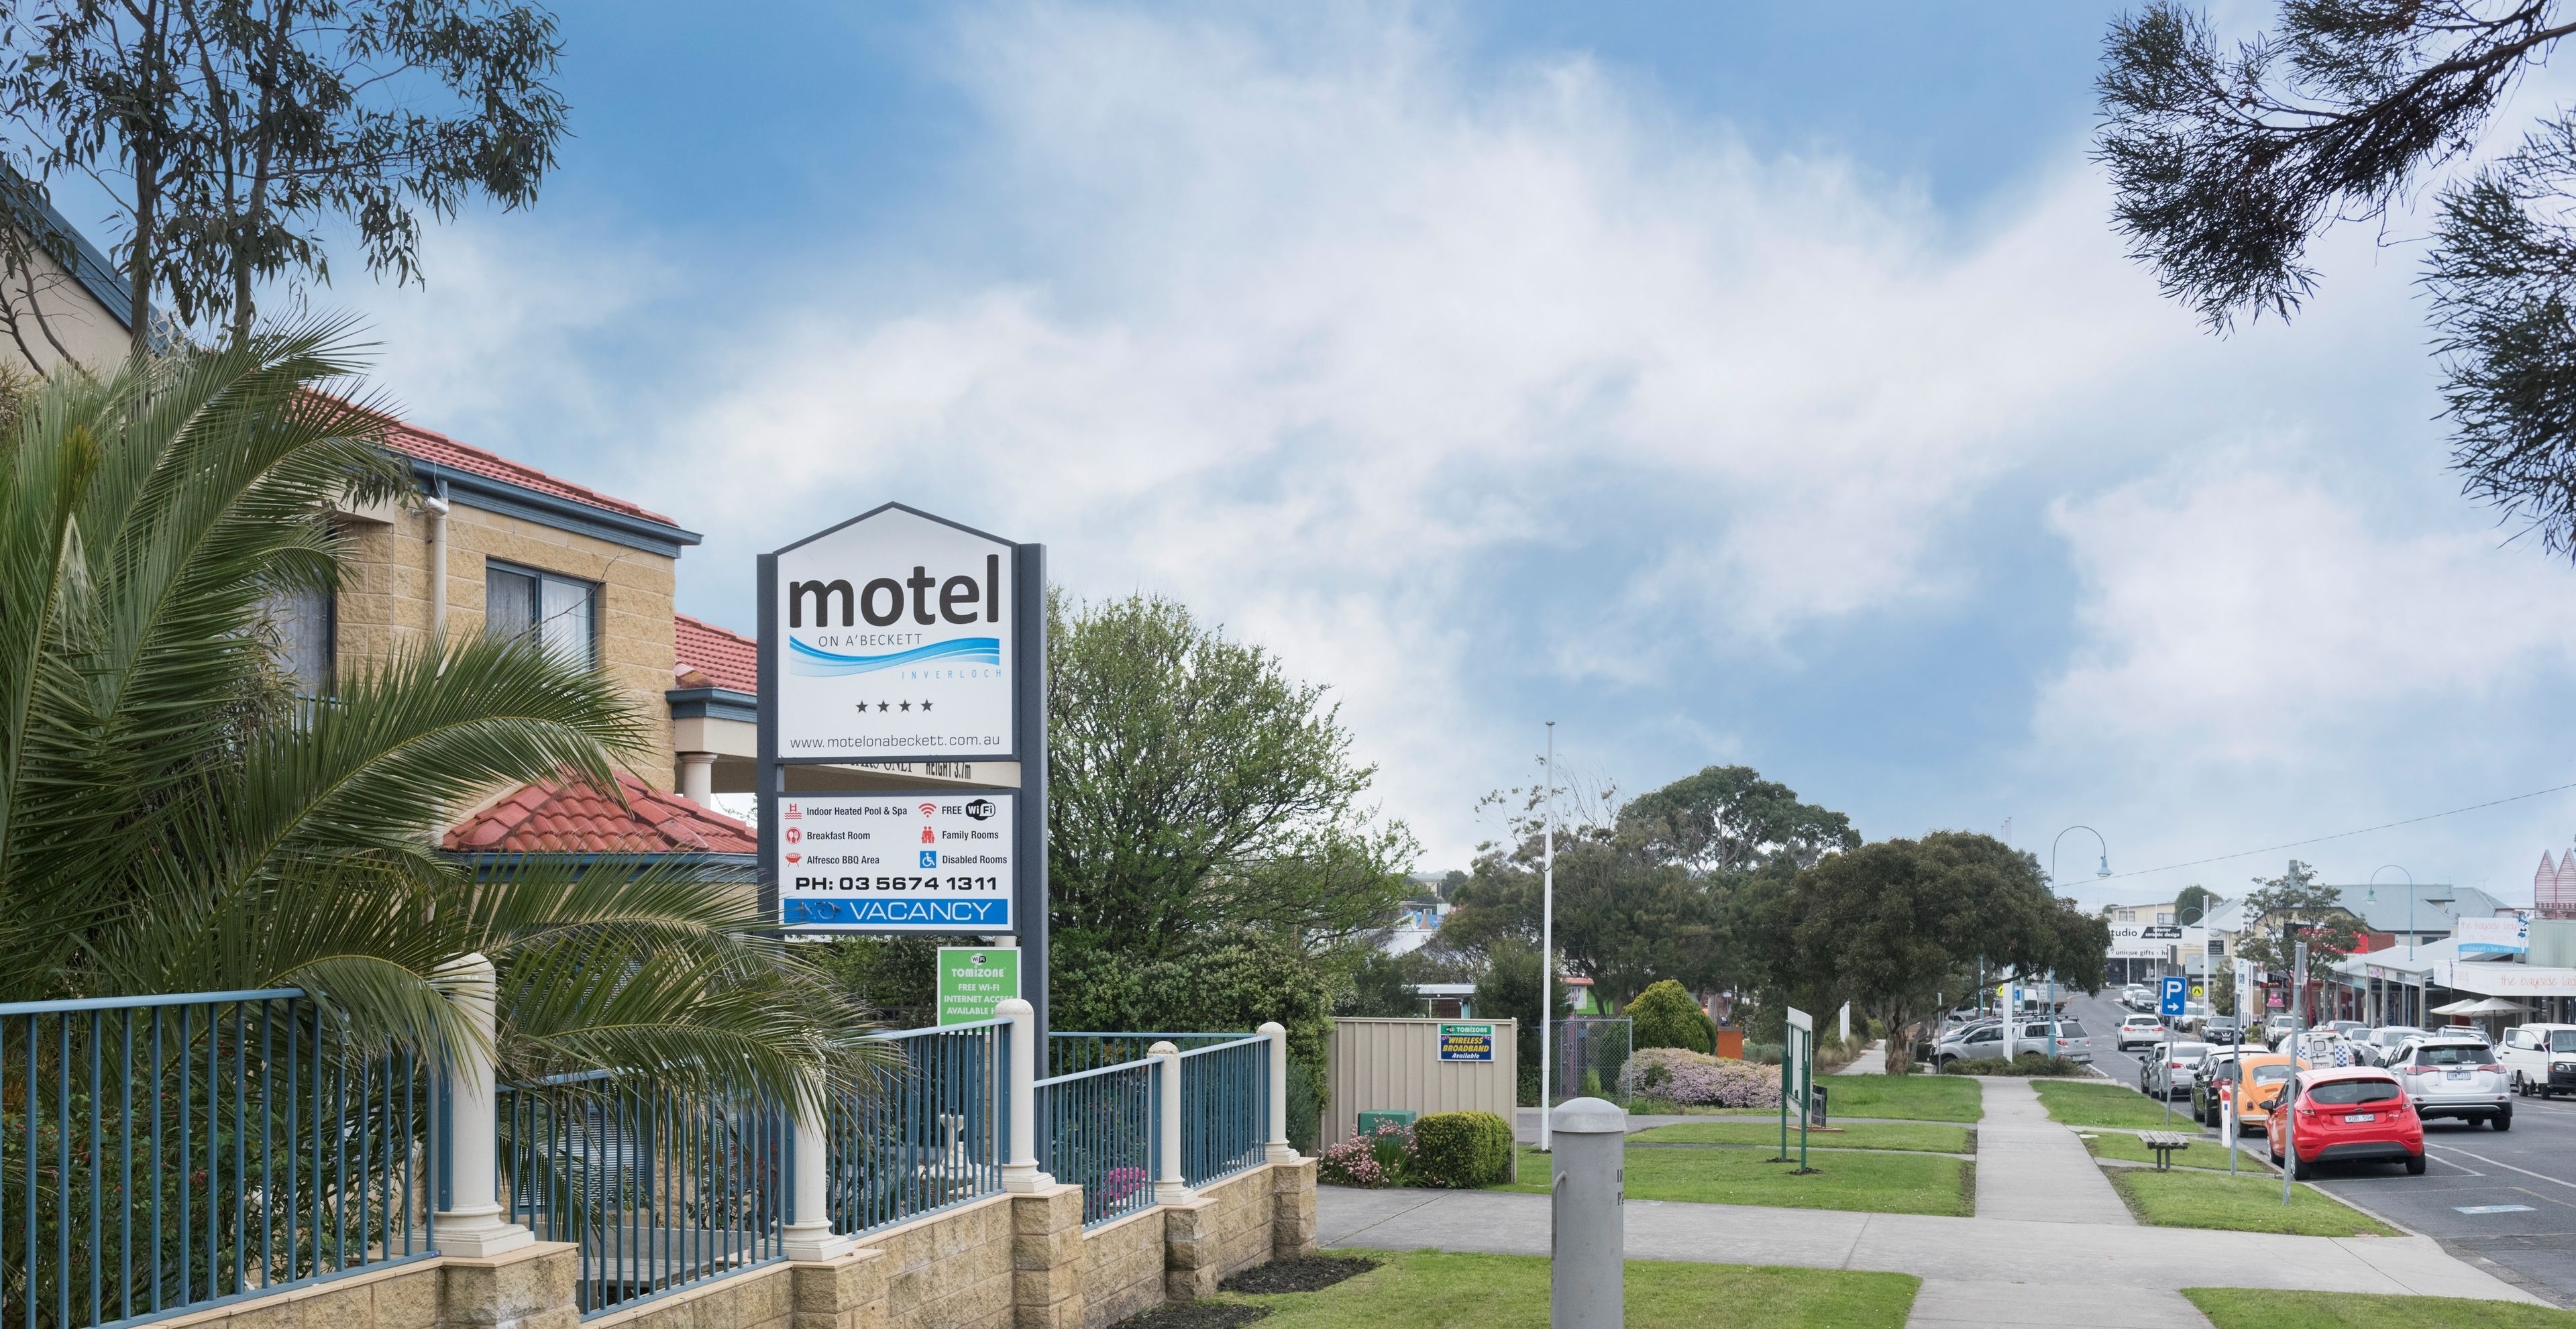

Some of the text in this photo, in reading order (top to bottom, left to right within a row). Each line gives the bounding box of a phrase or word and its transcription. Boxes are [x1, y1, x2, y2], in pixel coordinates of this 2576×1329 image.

[790, 554, 999, 628] motel
[818, 633, 922, 647] ON A'BECKETT
[902, 669, 1002, 680] INVERLOCH
[790, 735, 1000, 748] www.motelonabeckett.com.au
[807, 806, 907, 816] Indoor Heated Pool & Spa
[942, 806, 962, 814] FREE
[807, 831, 871, 840] Breakfast Room
[942, 831, 999, 841] Family Rooms
[807, 855, 879, 865] Alfresco BBQ Area
[943, 855, 1008, 864] Disabled Rooms
[796, 877, 996, 890] PH: 03 5674 1311
[849, 902, 993, 920] VACANCY
[2111, 928, 2137, 937] tudio
[2501, 975, 2516, 986] the
[2521, 975, 2558, 988] bayside
[2166, 981, 2182, 999] P
[944, 995, 982, 1003] INTERNET
